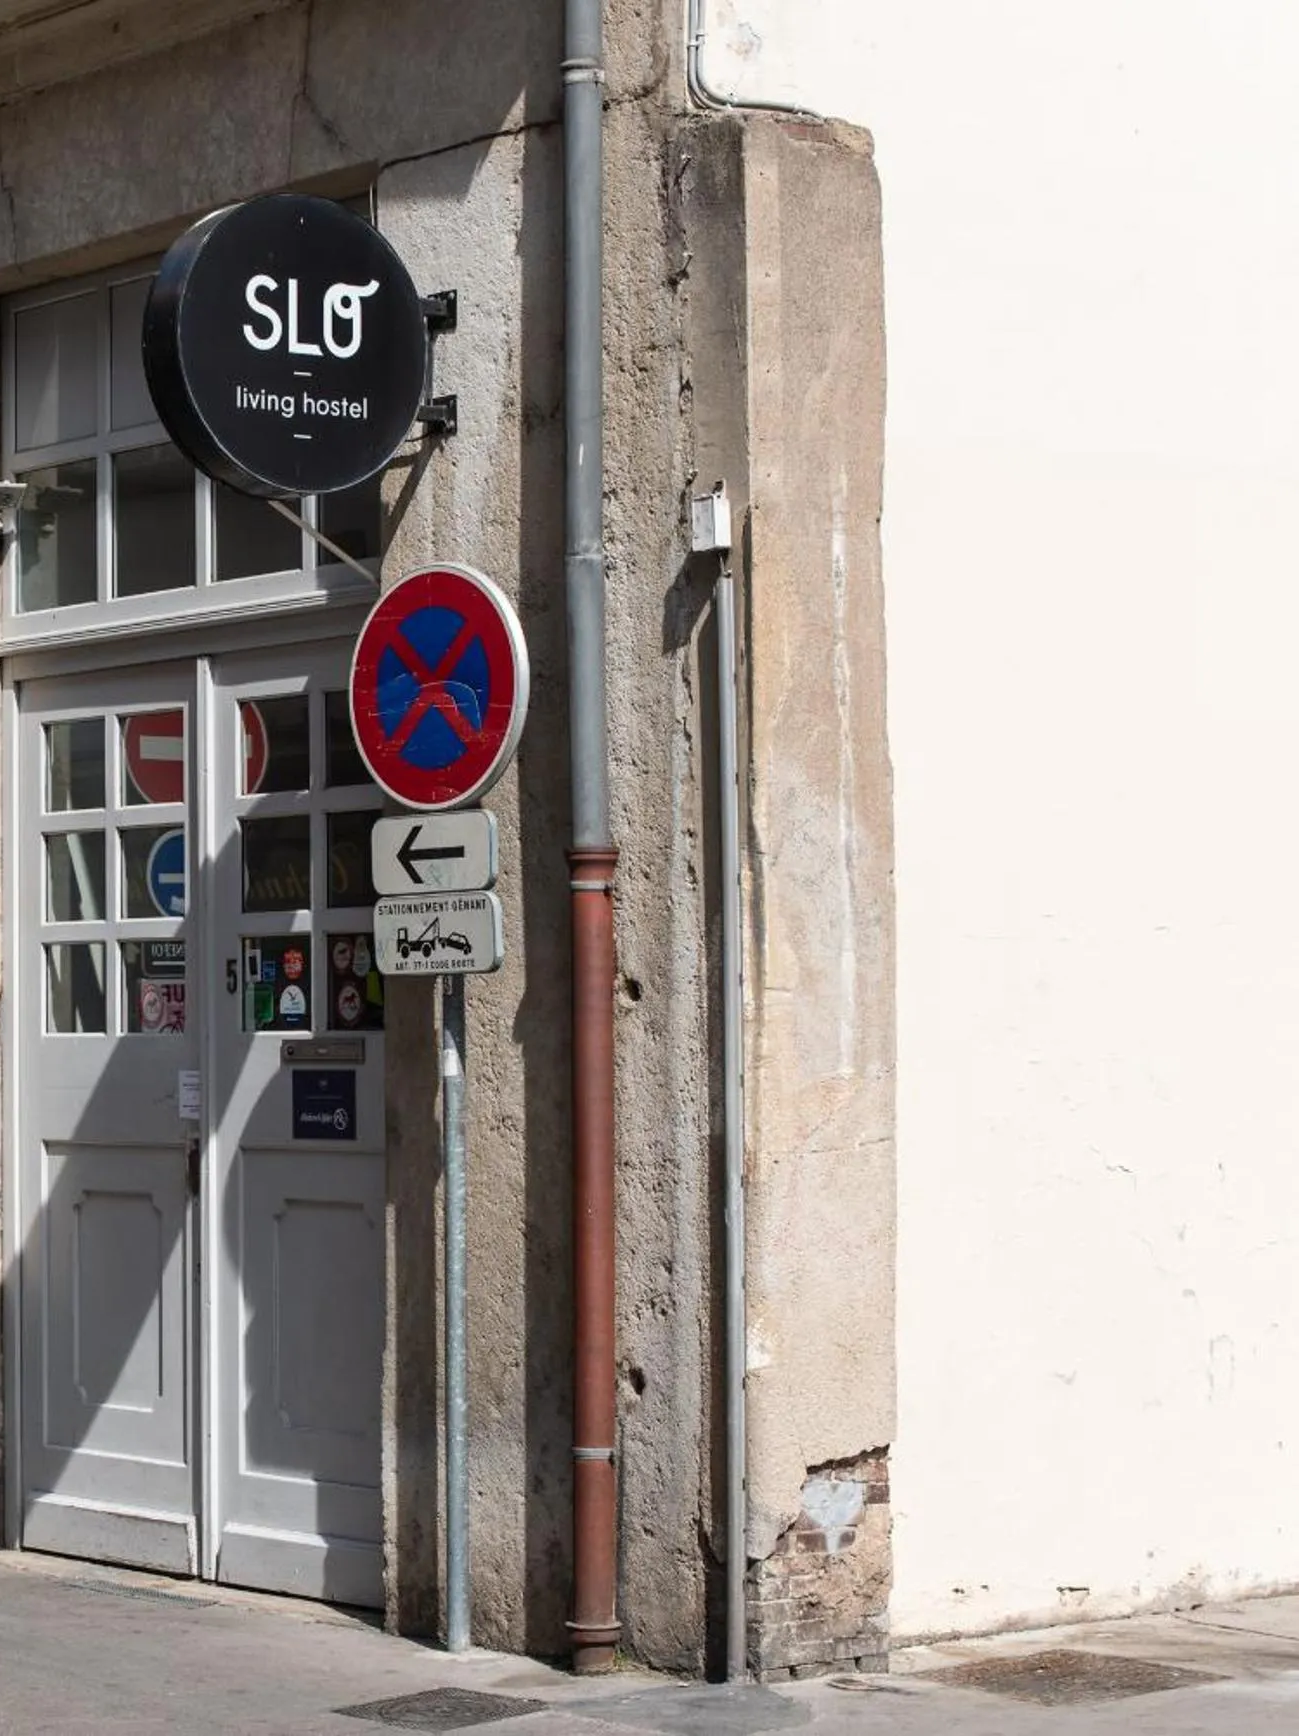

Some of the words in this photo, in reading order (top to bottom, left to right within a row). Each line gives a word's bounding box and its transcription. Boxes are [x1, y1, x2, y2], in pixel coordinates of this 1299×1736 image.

[243, 274, 380, 359] SLO
[236, 386, 295, 418] living
[303, 392, 368, 420] hostel
[378, 900, 449, 916] STATIONNEMENT
[226, 959, 238, 995] 5
